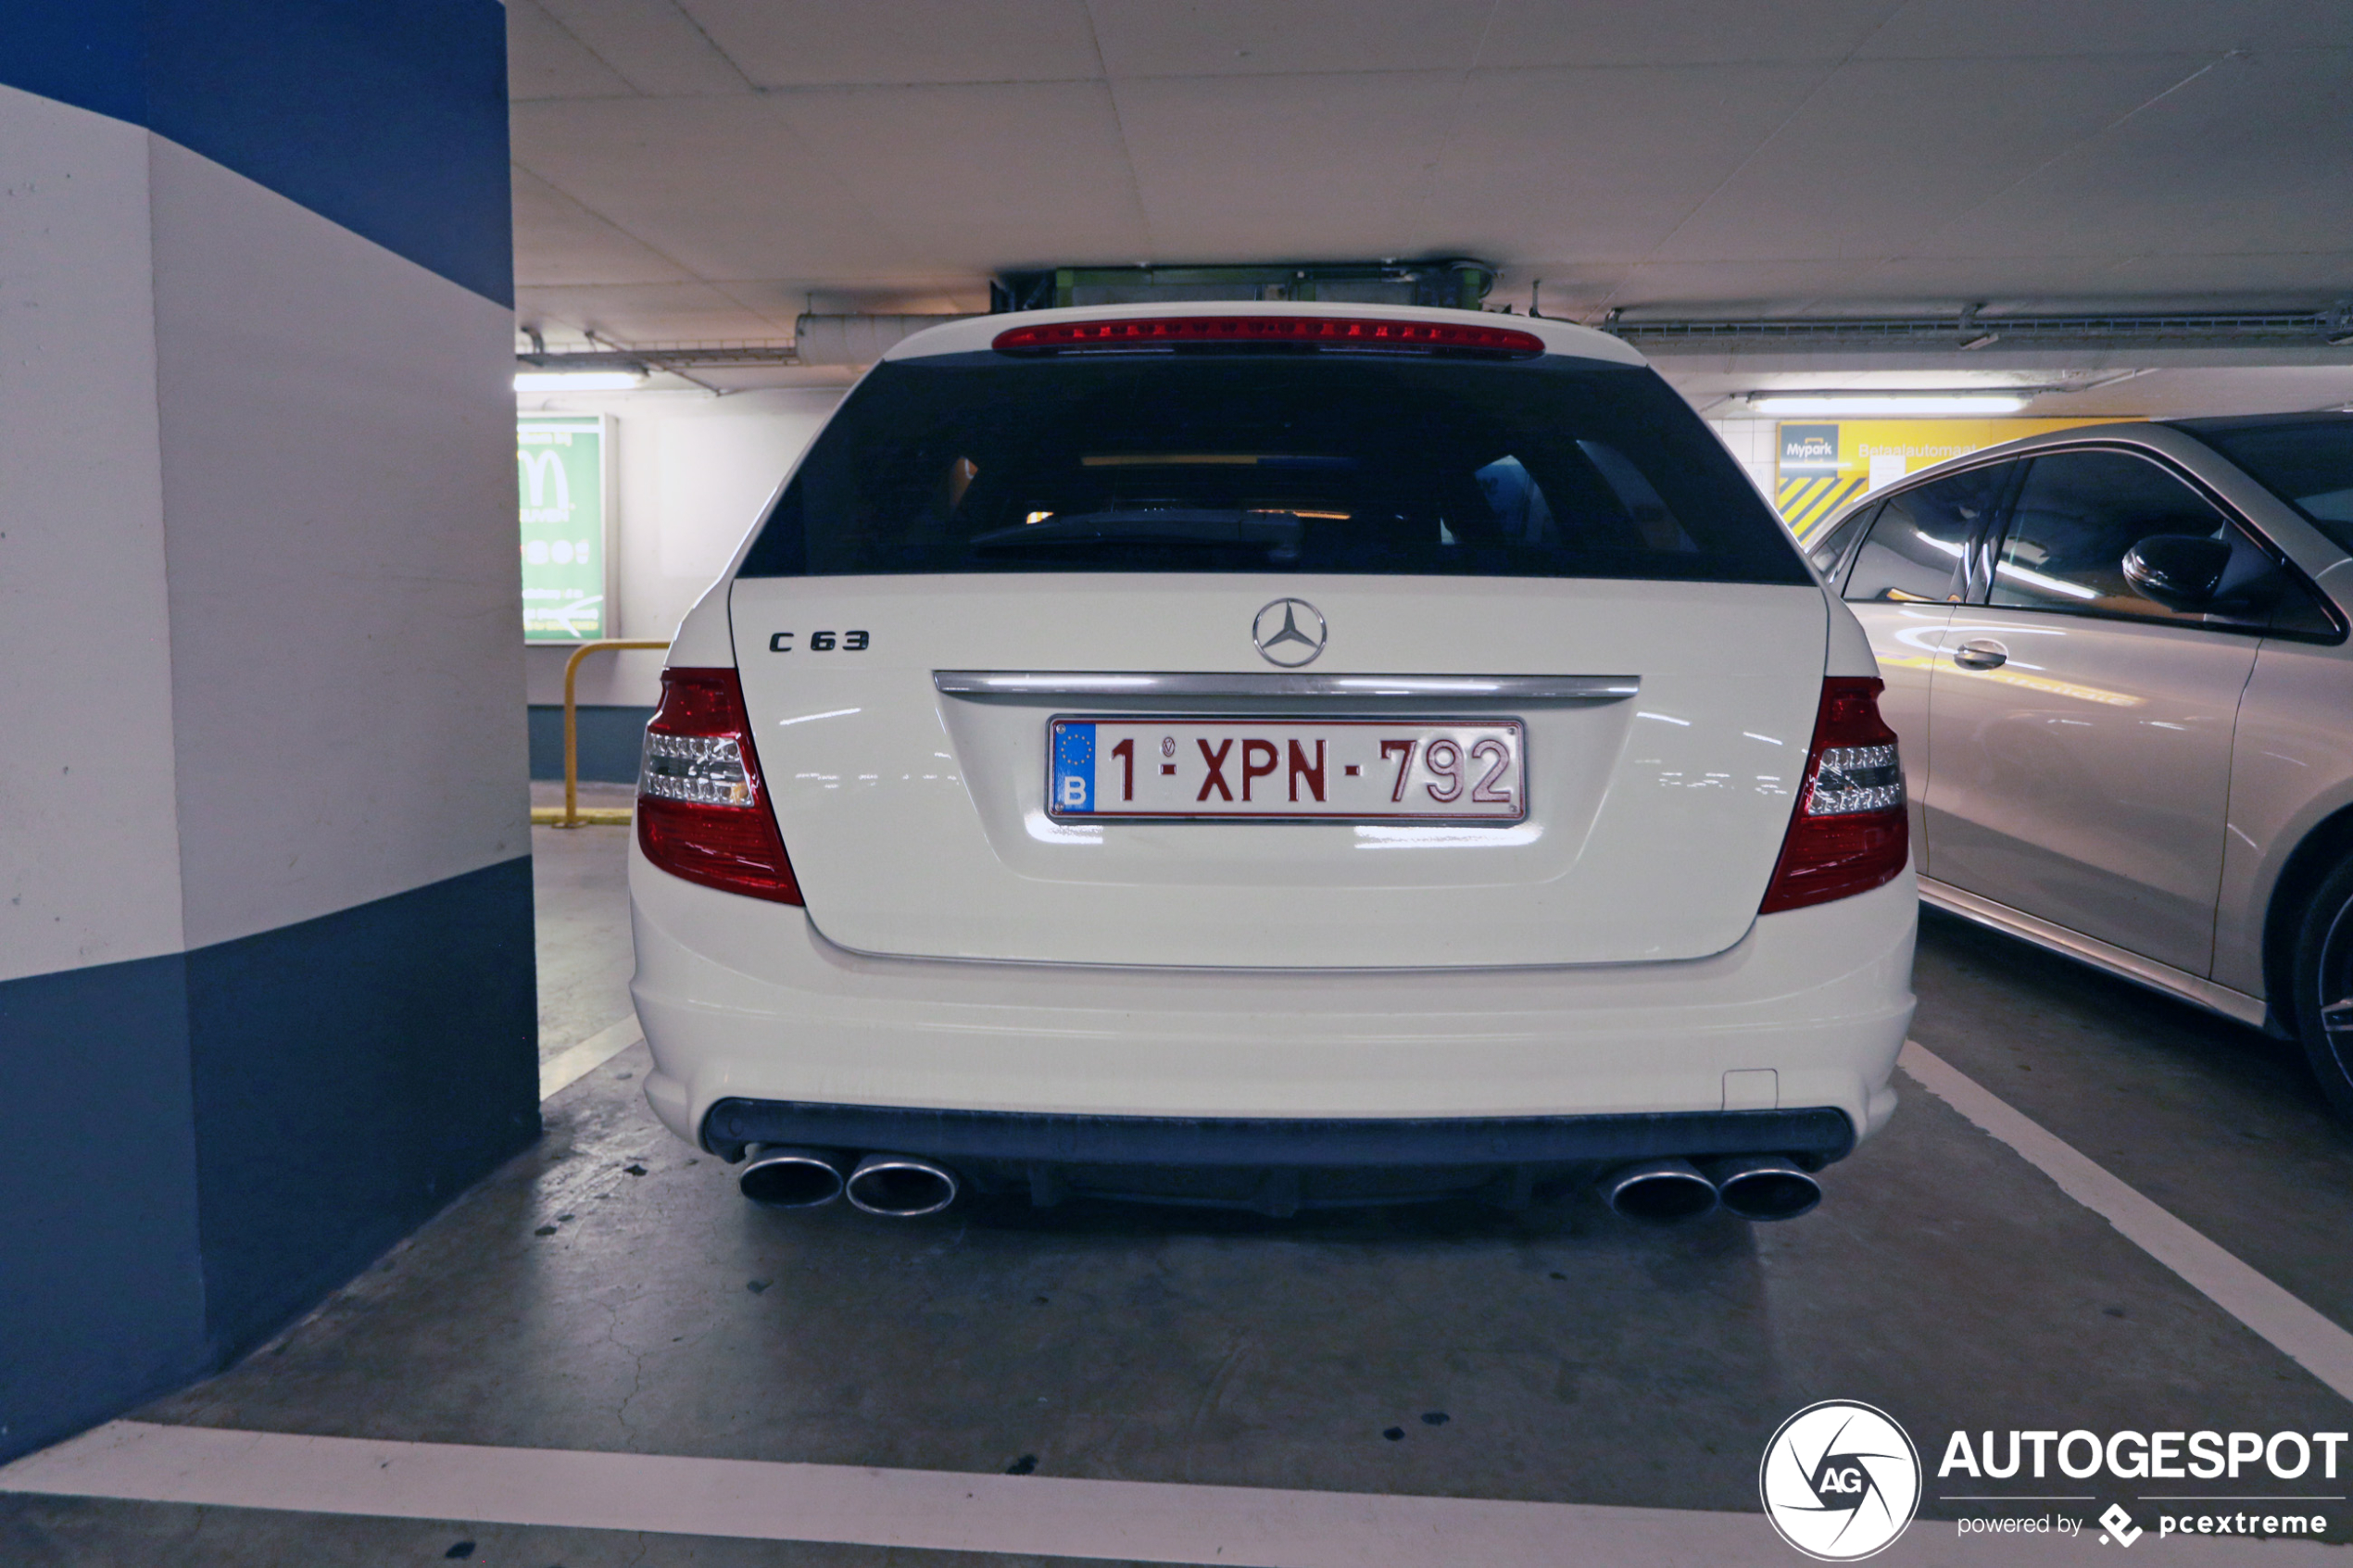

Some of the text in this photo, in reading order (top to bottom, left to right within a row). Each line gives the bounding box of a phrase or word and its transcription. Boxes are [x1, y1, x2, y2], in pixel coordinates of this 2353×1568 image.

[1787, 442, 1832, 458] Mypark
[1858, 443, 1977, 458] Betaalautomaat
[769, 630, 870, 652] C 63
[1064, 775, 1087, 805] B
